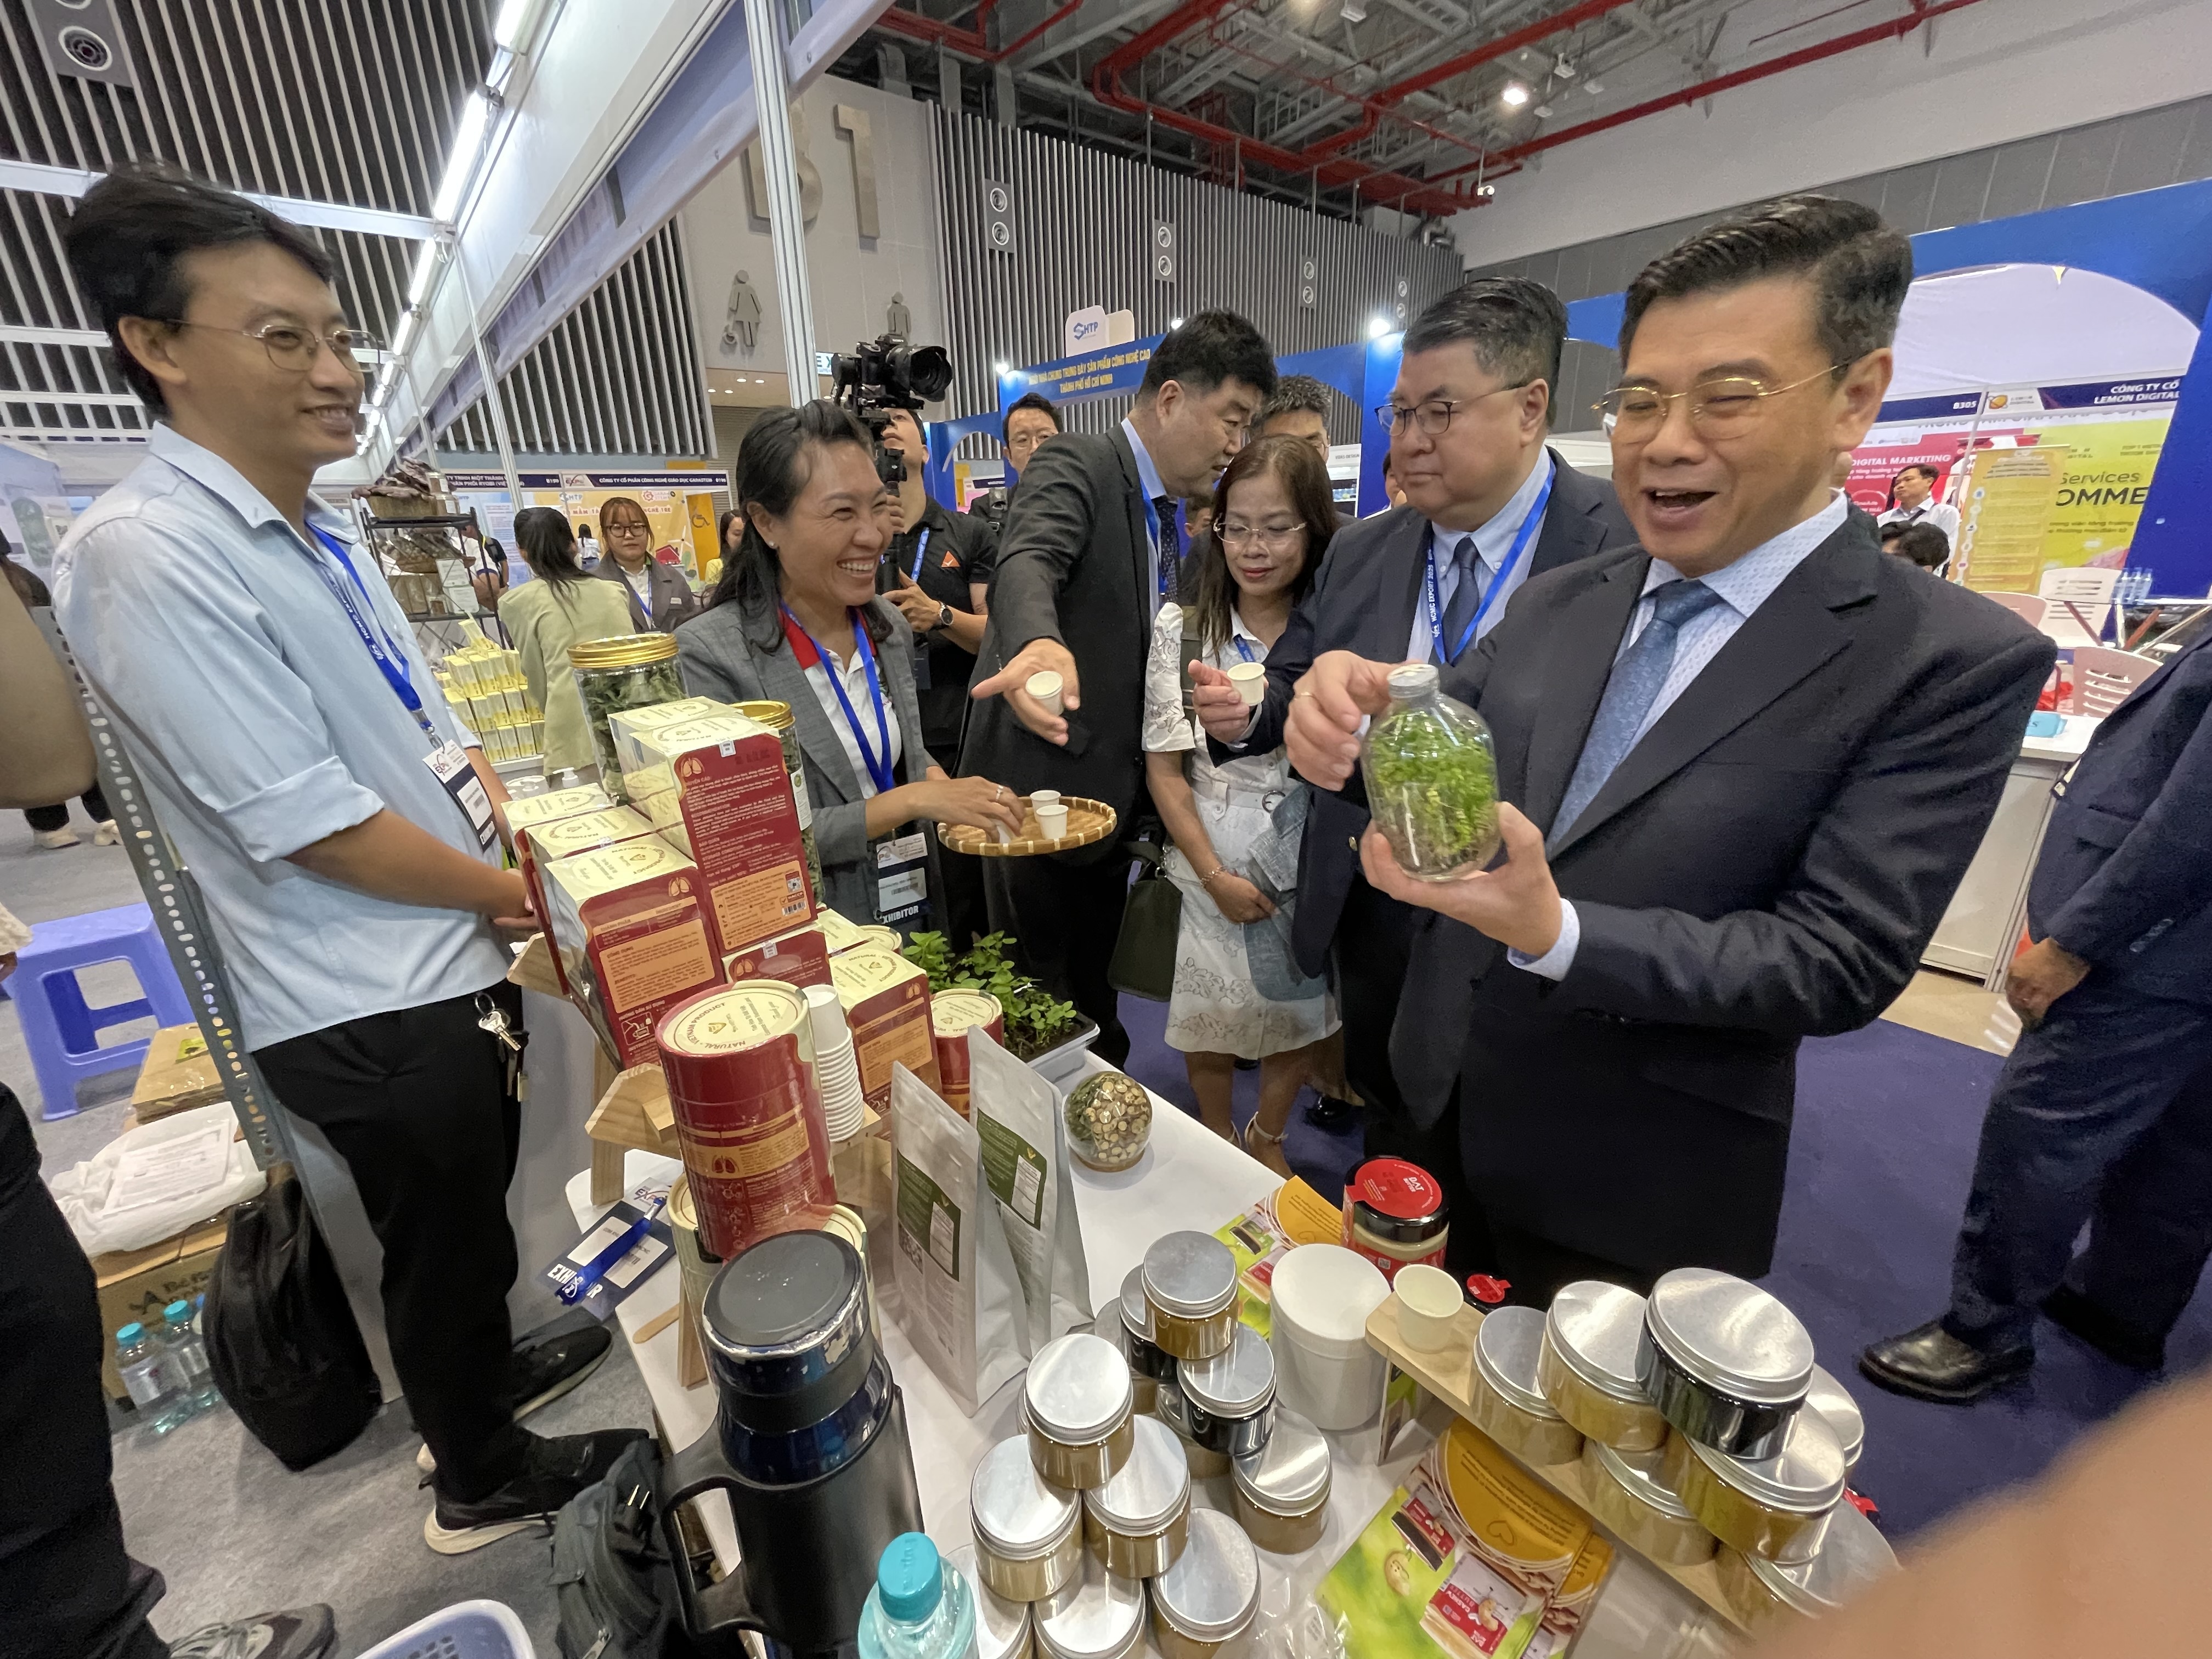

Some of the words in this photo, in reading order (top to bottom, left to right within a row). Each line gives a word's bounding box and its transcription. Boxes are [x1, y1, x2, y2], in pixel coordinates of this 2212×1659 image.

[1074, 321, 1098, 340] SHTP
[816, 355, 832, 368] EX
[1139, 349, 1150, 361] CAO
[2111, 383, 2144, 394] CÔNG
[2145, 383, 2160, 391] TY
[2094, 394, 2134, 404] LEMON
[2136, 391, 2180, 401] DIGITAL
[1953, 401, 1977, 410] B305
[1852, 458, 1887, 466] DIGITAL
[1890, 454, 1951, 464] MARKETING
[2061, 471, 2140, 484] Services
[2056, 487, 2150, 506] OMME
[881, 906, 919, 924] XHIBITOR
[691, 1002, 726, 1025] PRODUCT
[686, 1024, 700, 1045] VIETNAM
[704, 1040, 746, 1049] NATURAL
[548, 1263, 603, 1299] EXHIR
